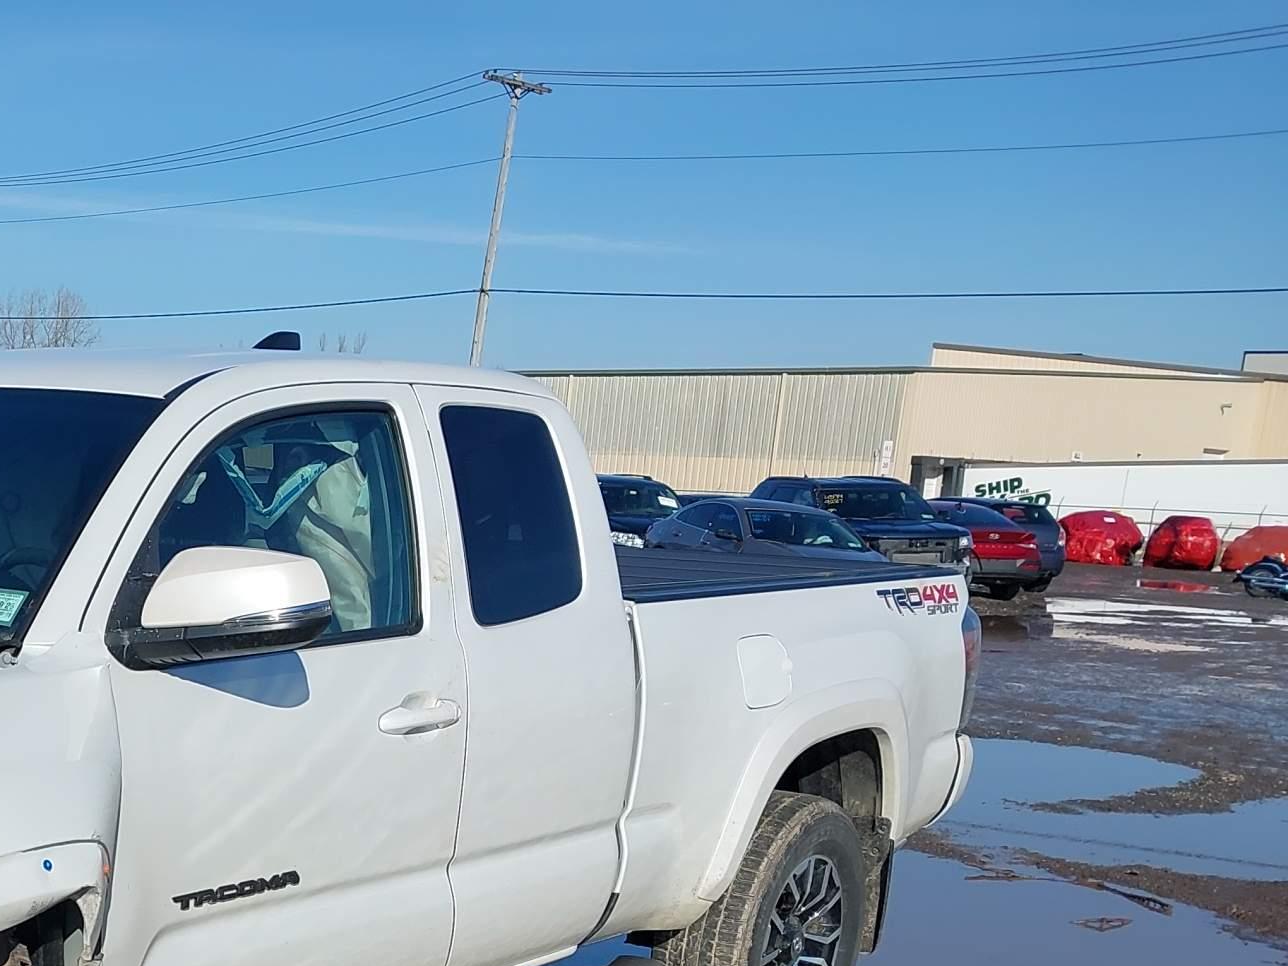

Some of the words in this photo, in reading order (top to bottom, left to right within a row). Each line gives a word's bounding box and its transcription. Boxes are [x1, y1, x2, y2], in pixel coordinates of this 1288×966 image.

[974, 477, 1023, 498] SHIP
[876, 587, 925, 616] TRD
[926, 603, 959, 616] SPORT
[172, 870, 300, 911] TACOMA
